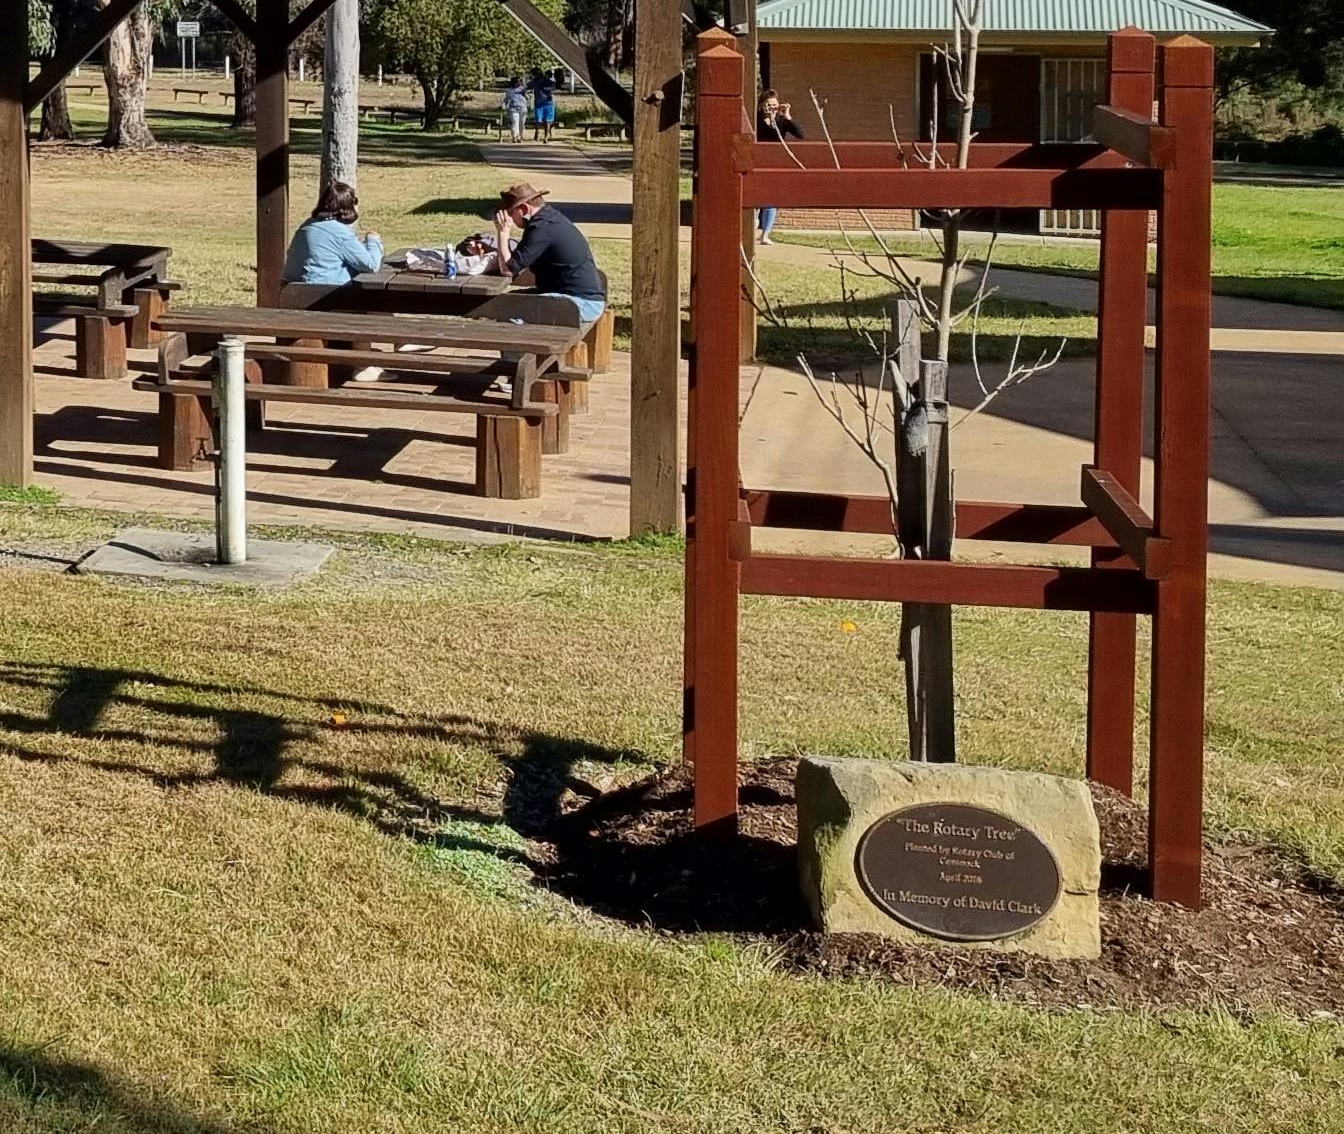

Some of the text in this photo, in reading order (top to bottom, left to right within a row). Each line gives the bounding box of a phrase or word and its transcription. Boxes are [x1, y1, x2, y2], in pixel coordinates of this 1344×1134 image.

[896, 817, 1021, 841] "The Rotary Tree"
[904, 842, 1015, 861] Planted by Rotary Club of
[939, 871, 961, 883] April
[883, 888, 1043, 916] In Memory of David Clark
